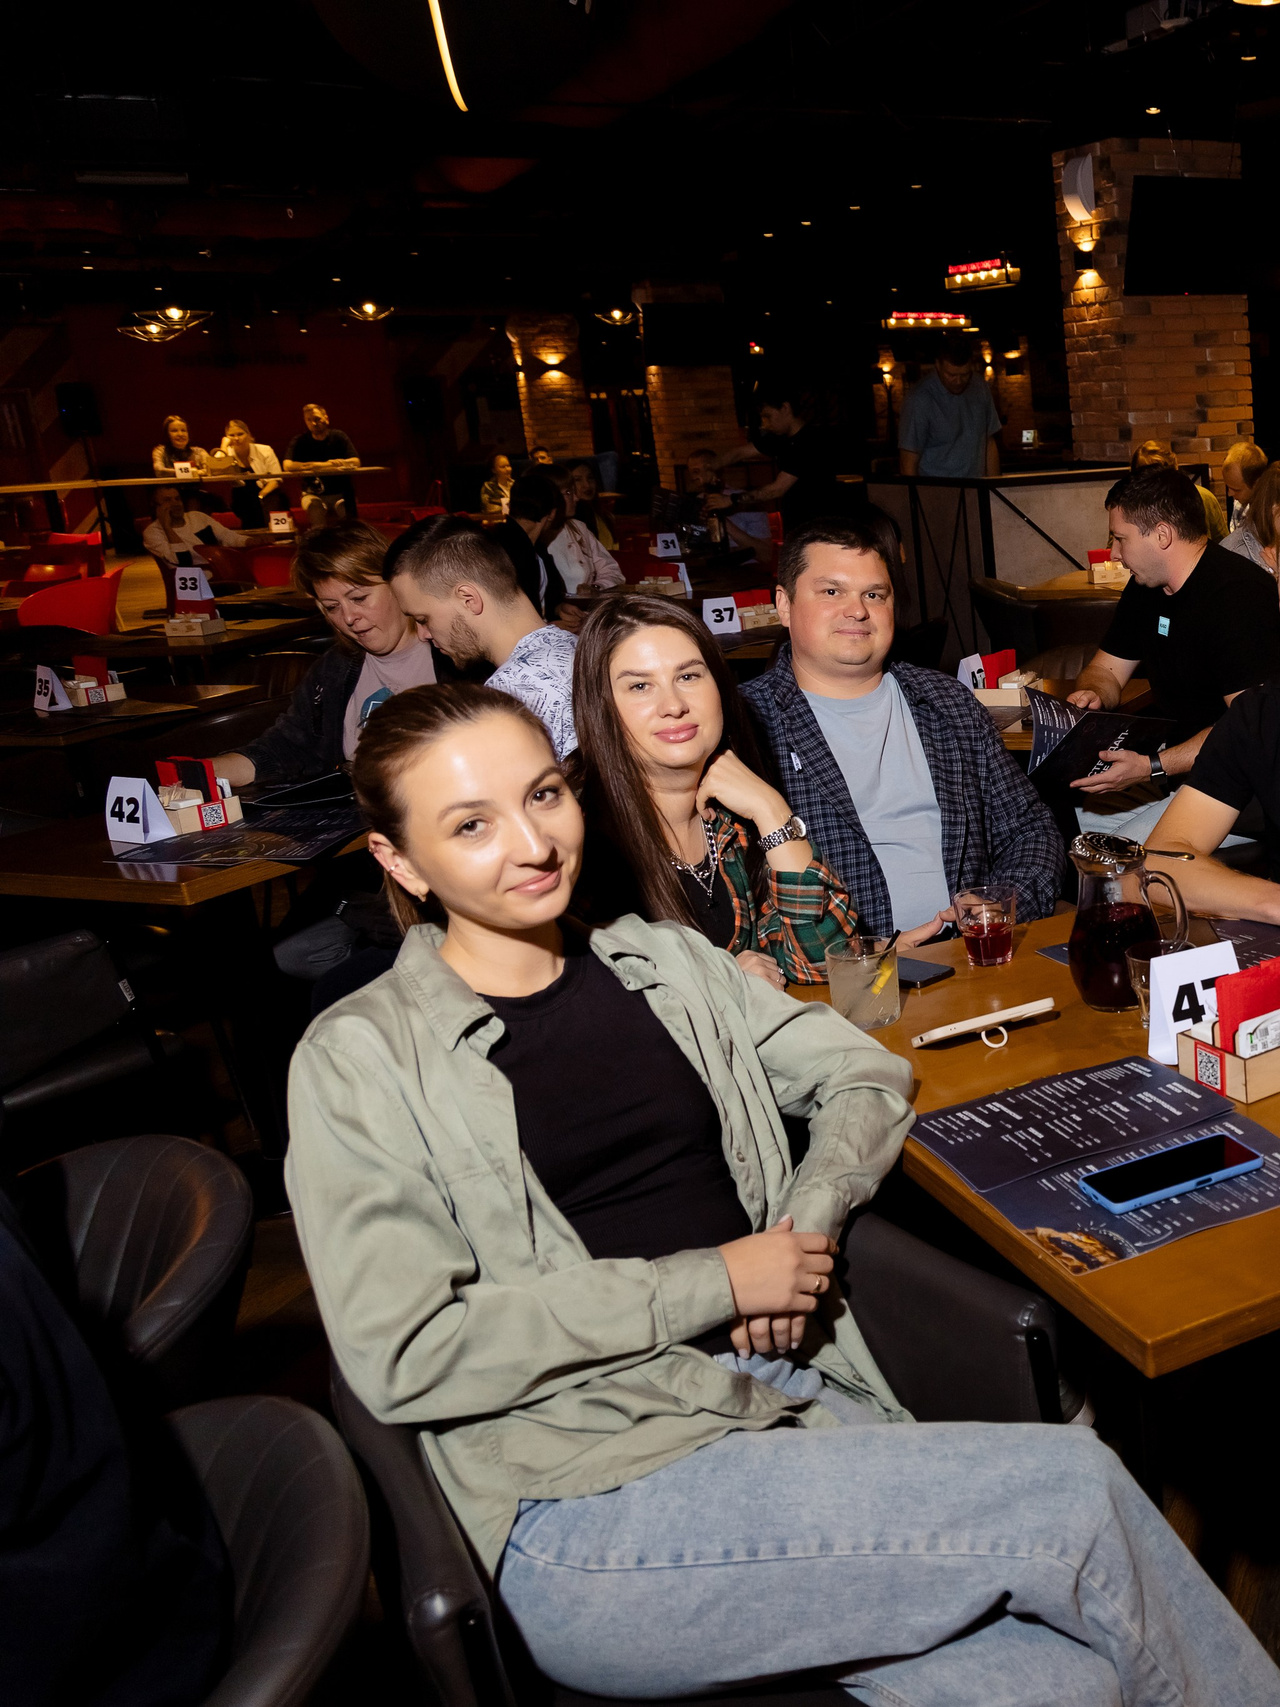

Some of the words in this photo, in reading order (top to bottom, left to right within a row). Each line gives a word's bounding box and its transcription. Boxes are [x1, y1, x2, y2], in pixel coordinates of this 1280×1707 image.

[273, 517, 287, 526] 20
[178, 577, 198, 591] 33
[711, 607, 735, 623] 37
[36, 678, 50, 697] 35
[110, 796, 141, 824] 42
